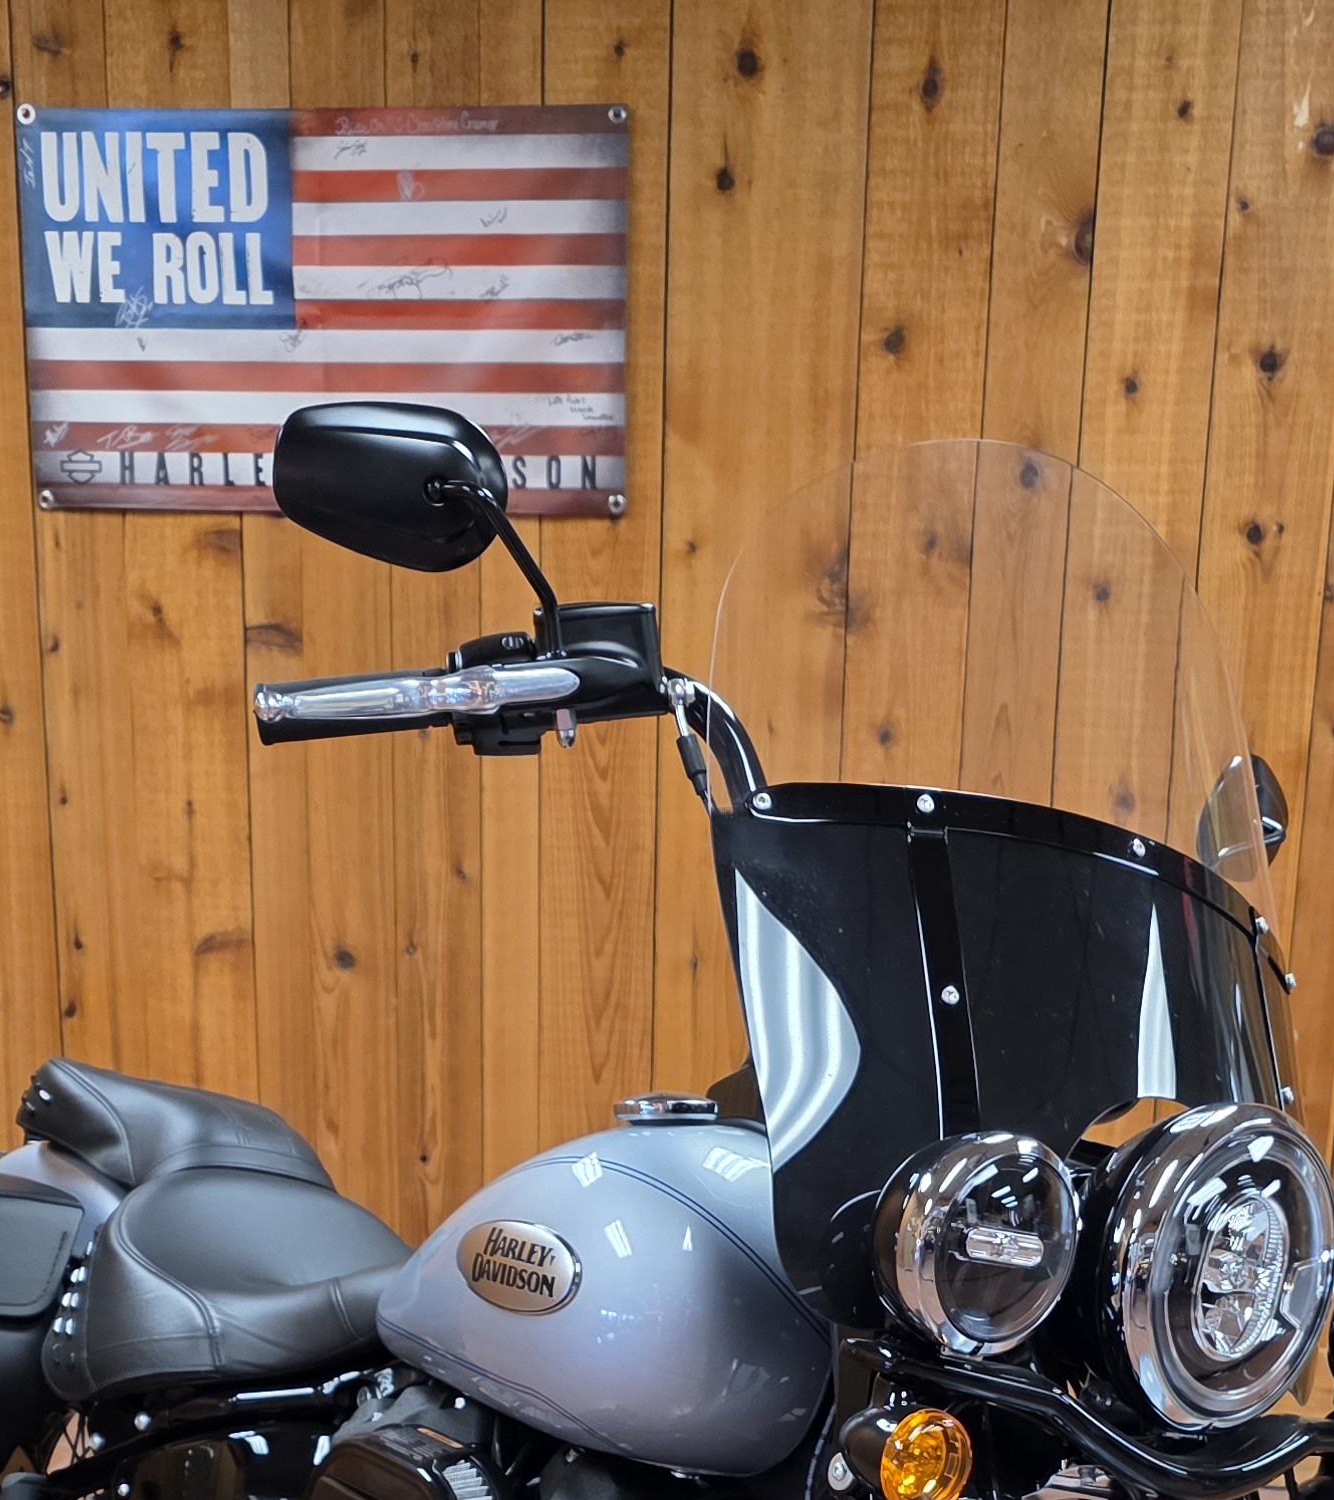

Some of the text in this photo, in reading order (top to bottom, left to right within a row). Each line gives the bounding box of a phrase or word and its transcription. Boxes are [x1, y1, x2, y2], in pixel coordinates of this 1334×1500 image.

[41, 131, 268, 223] UNITED
[44, 231, 126, 303] WE
[152, 231, 274, 304] ROLL
[472, 1253, 556, 1298] DAVIDSON
